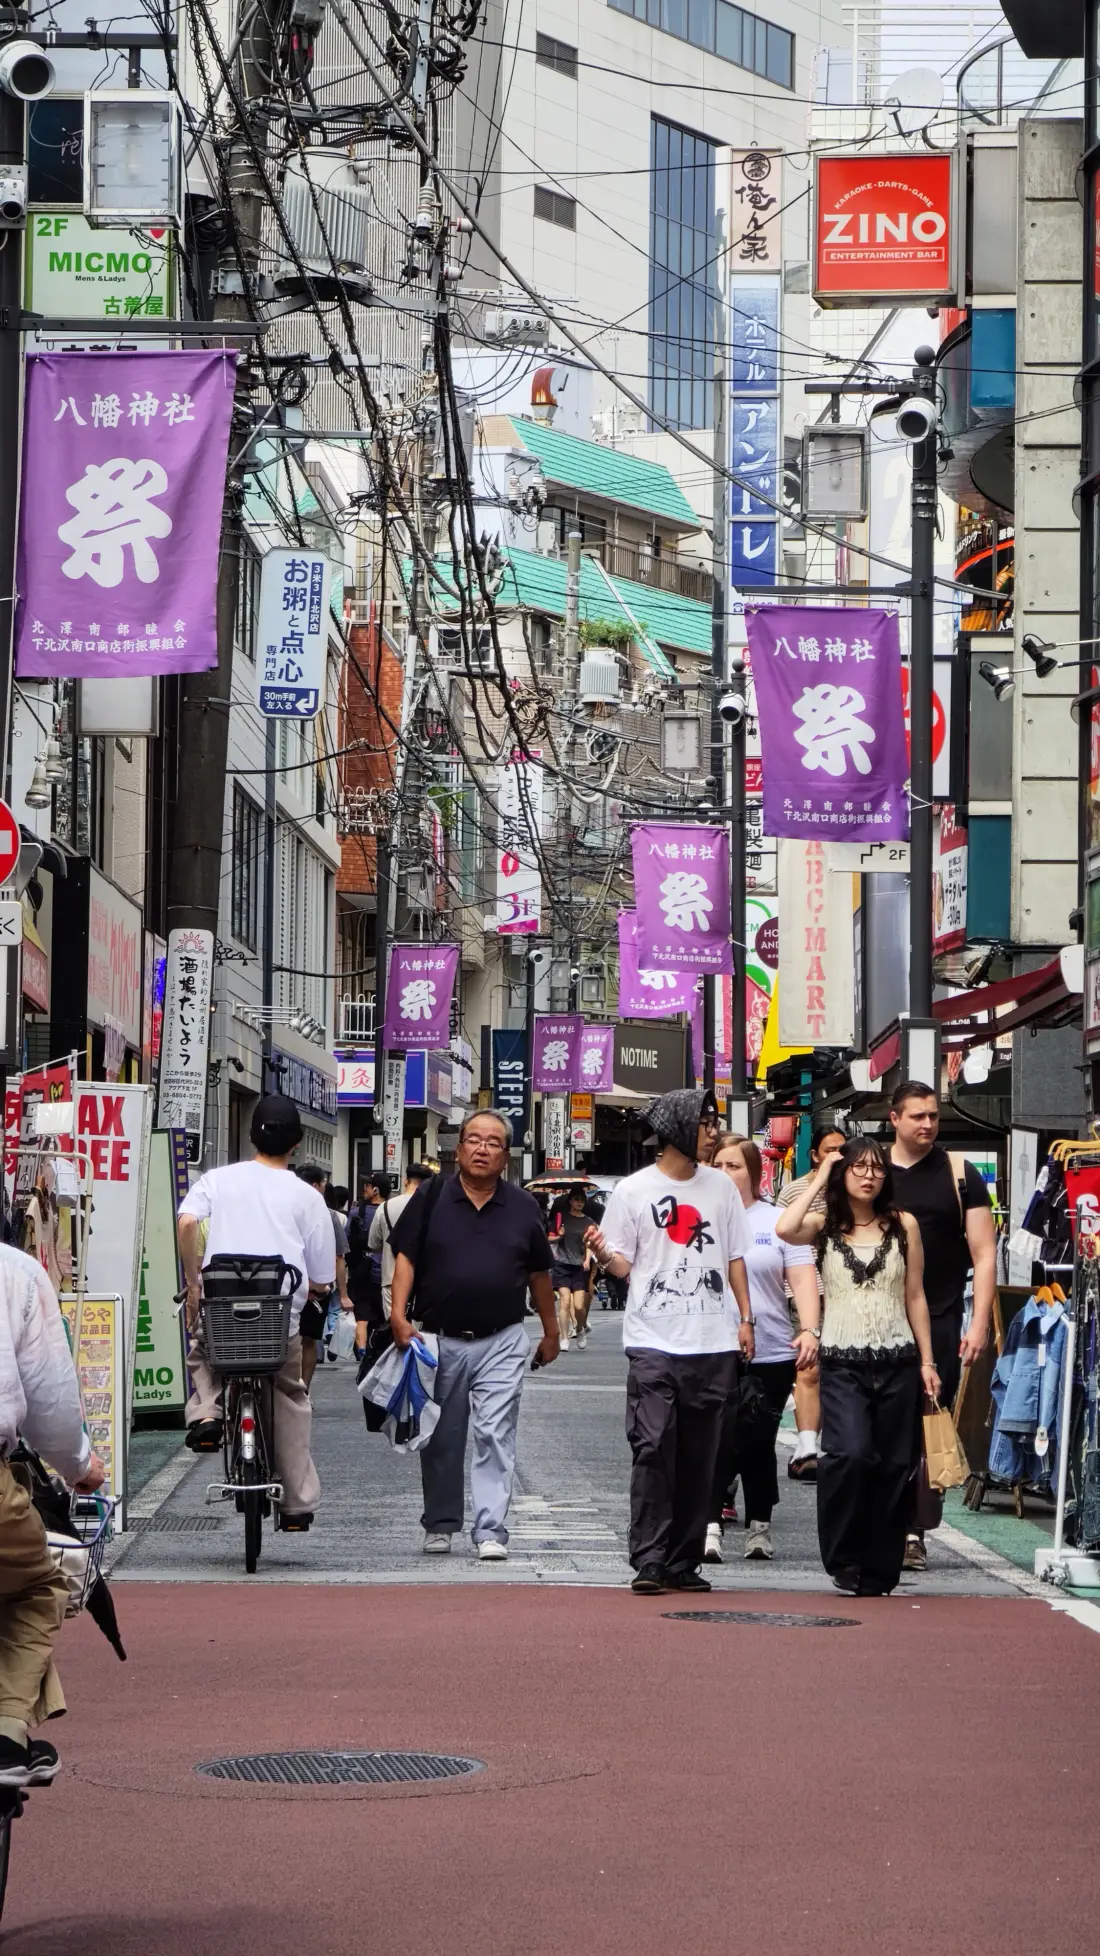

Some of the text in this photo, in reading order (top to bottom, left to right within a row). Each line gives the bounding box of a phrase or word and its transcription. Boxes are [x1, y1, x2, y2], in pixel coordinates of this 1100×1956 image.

[834, 181, 934, 209] KARAOKE DARTS GAME
[37, 218, 68, 236] 2F
[735, 182, 777, 263] 俺ん家
[823, 211, 946, 244] ZINO
[49, 252, 152, 273] MICMO
[830, 251, 938, 260] ENTERTAINMENT BAR
[103, 296, 164, 315] 古着屋
[745, 316, 766, 383] ホテル
[54, 391, 196, 428] 八幡神社
[739, 401, 771, 560] アンドレ
[58, 457, 172, 588] 祭
[309, 564, 322, 633] 3米3 下北沢店
[32, 619, 186, 637] 北澤南部睦会
[278, 559, 309, 683] お粥と点心
[31, 635, 187, 653] 下北沢南口商店街振興組合
[774, 636, 876, 663] 八幡神社
[264, 645, 277, 681] 専門店
[264, 691, 296, 702] 30m手前
[266, 701, 293, 710] 左入る
[792, 683, 876, 777] 祭
[783, 798, 892, 812] 北澤南部睦会
[783, 811, 892, 824] 下北沢南口商店街振興組合
[649, 843, 715, 860] 八幡神社
[889, 850, 907, 860] 2F
[659, 871, 713, 932] 祭
[400, 960, 445, 971] 八幡神社
[179, 956, 198, 1066] 酒場たいよう
[399, 980, 437, 1021] 祭
[541, 1025, 575, 1034] 八幡神社
[581, 1034, 607, 1043] 八幡神社
[542, 1040, 570, 1071] 祭
[582, 1048, 604, 1075] 祭
[621, 1047, 658, 1069] NOTIME
[498, 1061, 524, 1116] STEPS
[78, 1095, 125, 1136] AX
[651, 1195, 715, 1254] 日本
